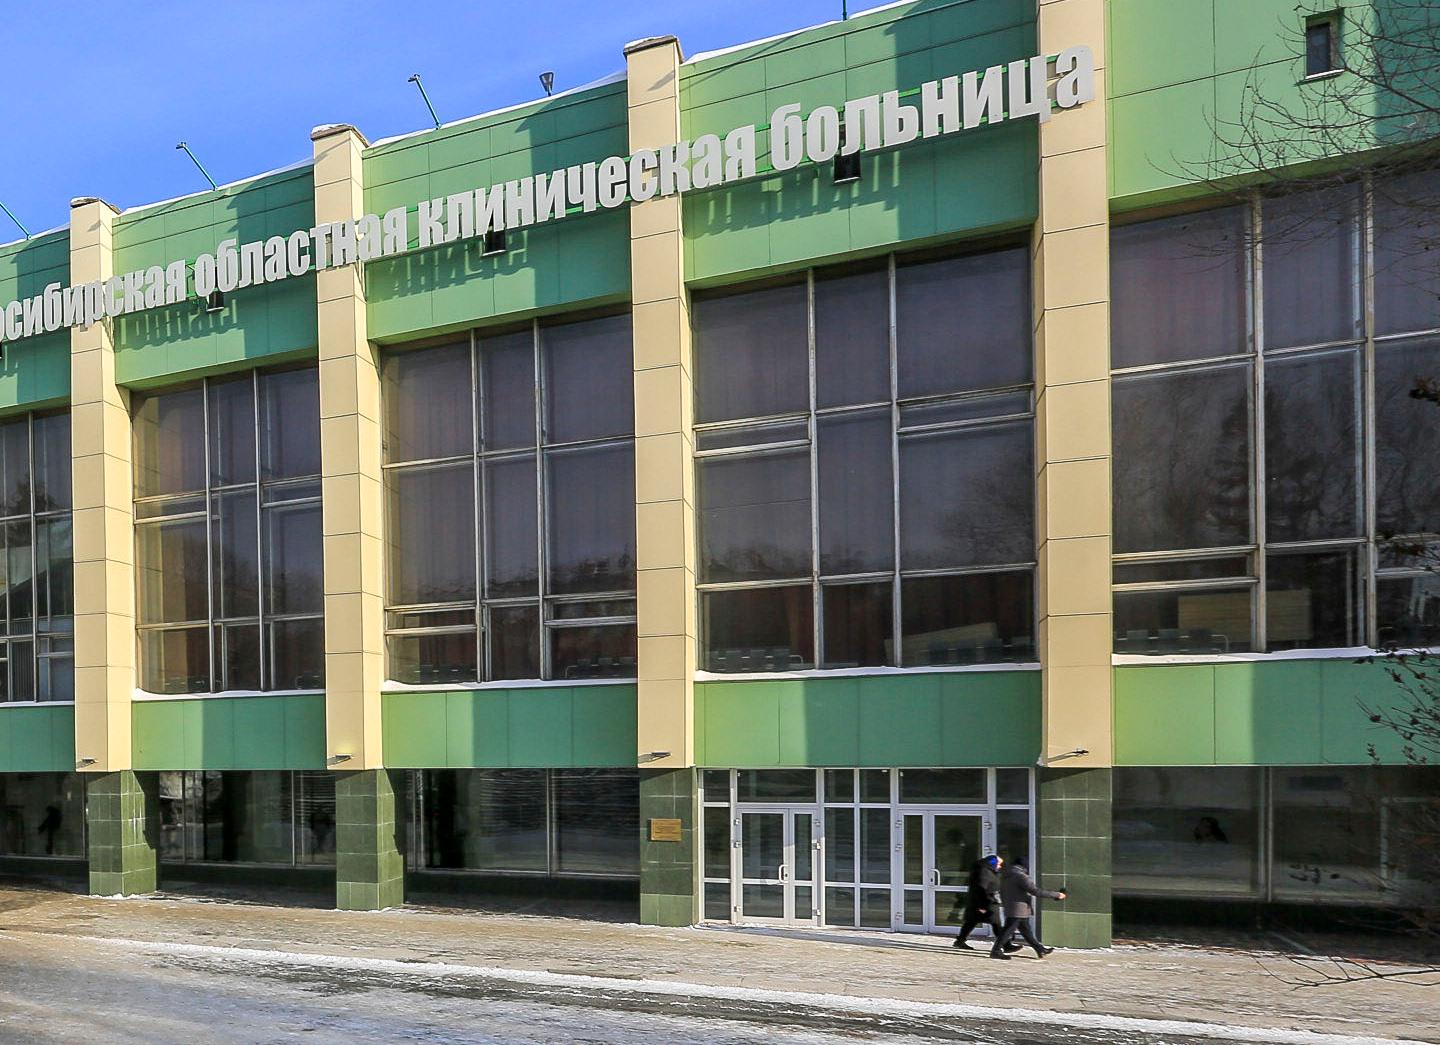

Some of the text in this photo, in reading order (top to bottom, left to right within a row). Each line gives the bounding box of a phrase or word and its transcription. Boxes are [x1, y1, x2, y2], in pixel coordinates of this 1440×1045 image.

[194, 206, 408, 298] областная
[418, 125, 756, 248] клиническая
[771, 45, 1095, 172] больница
